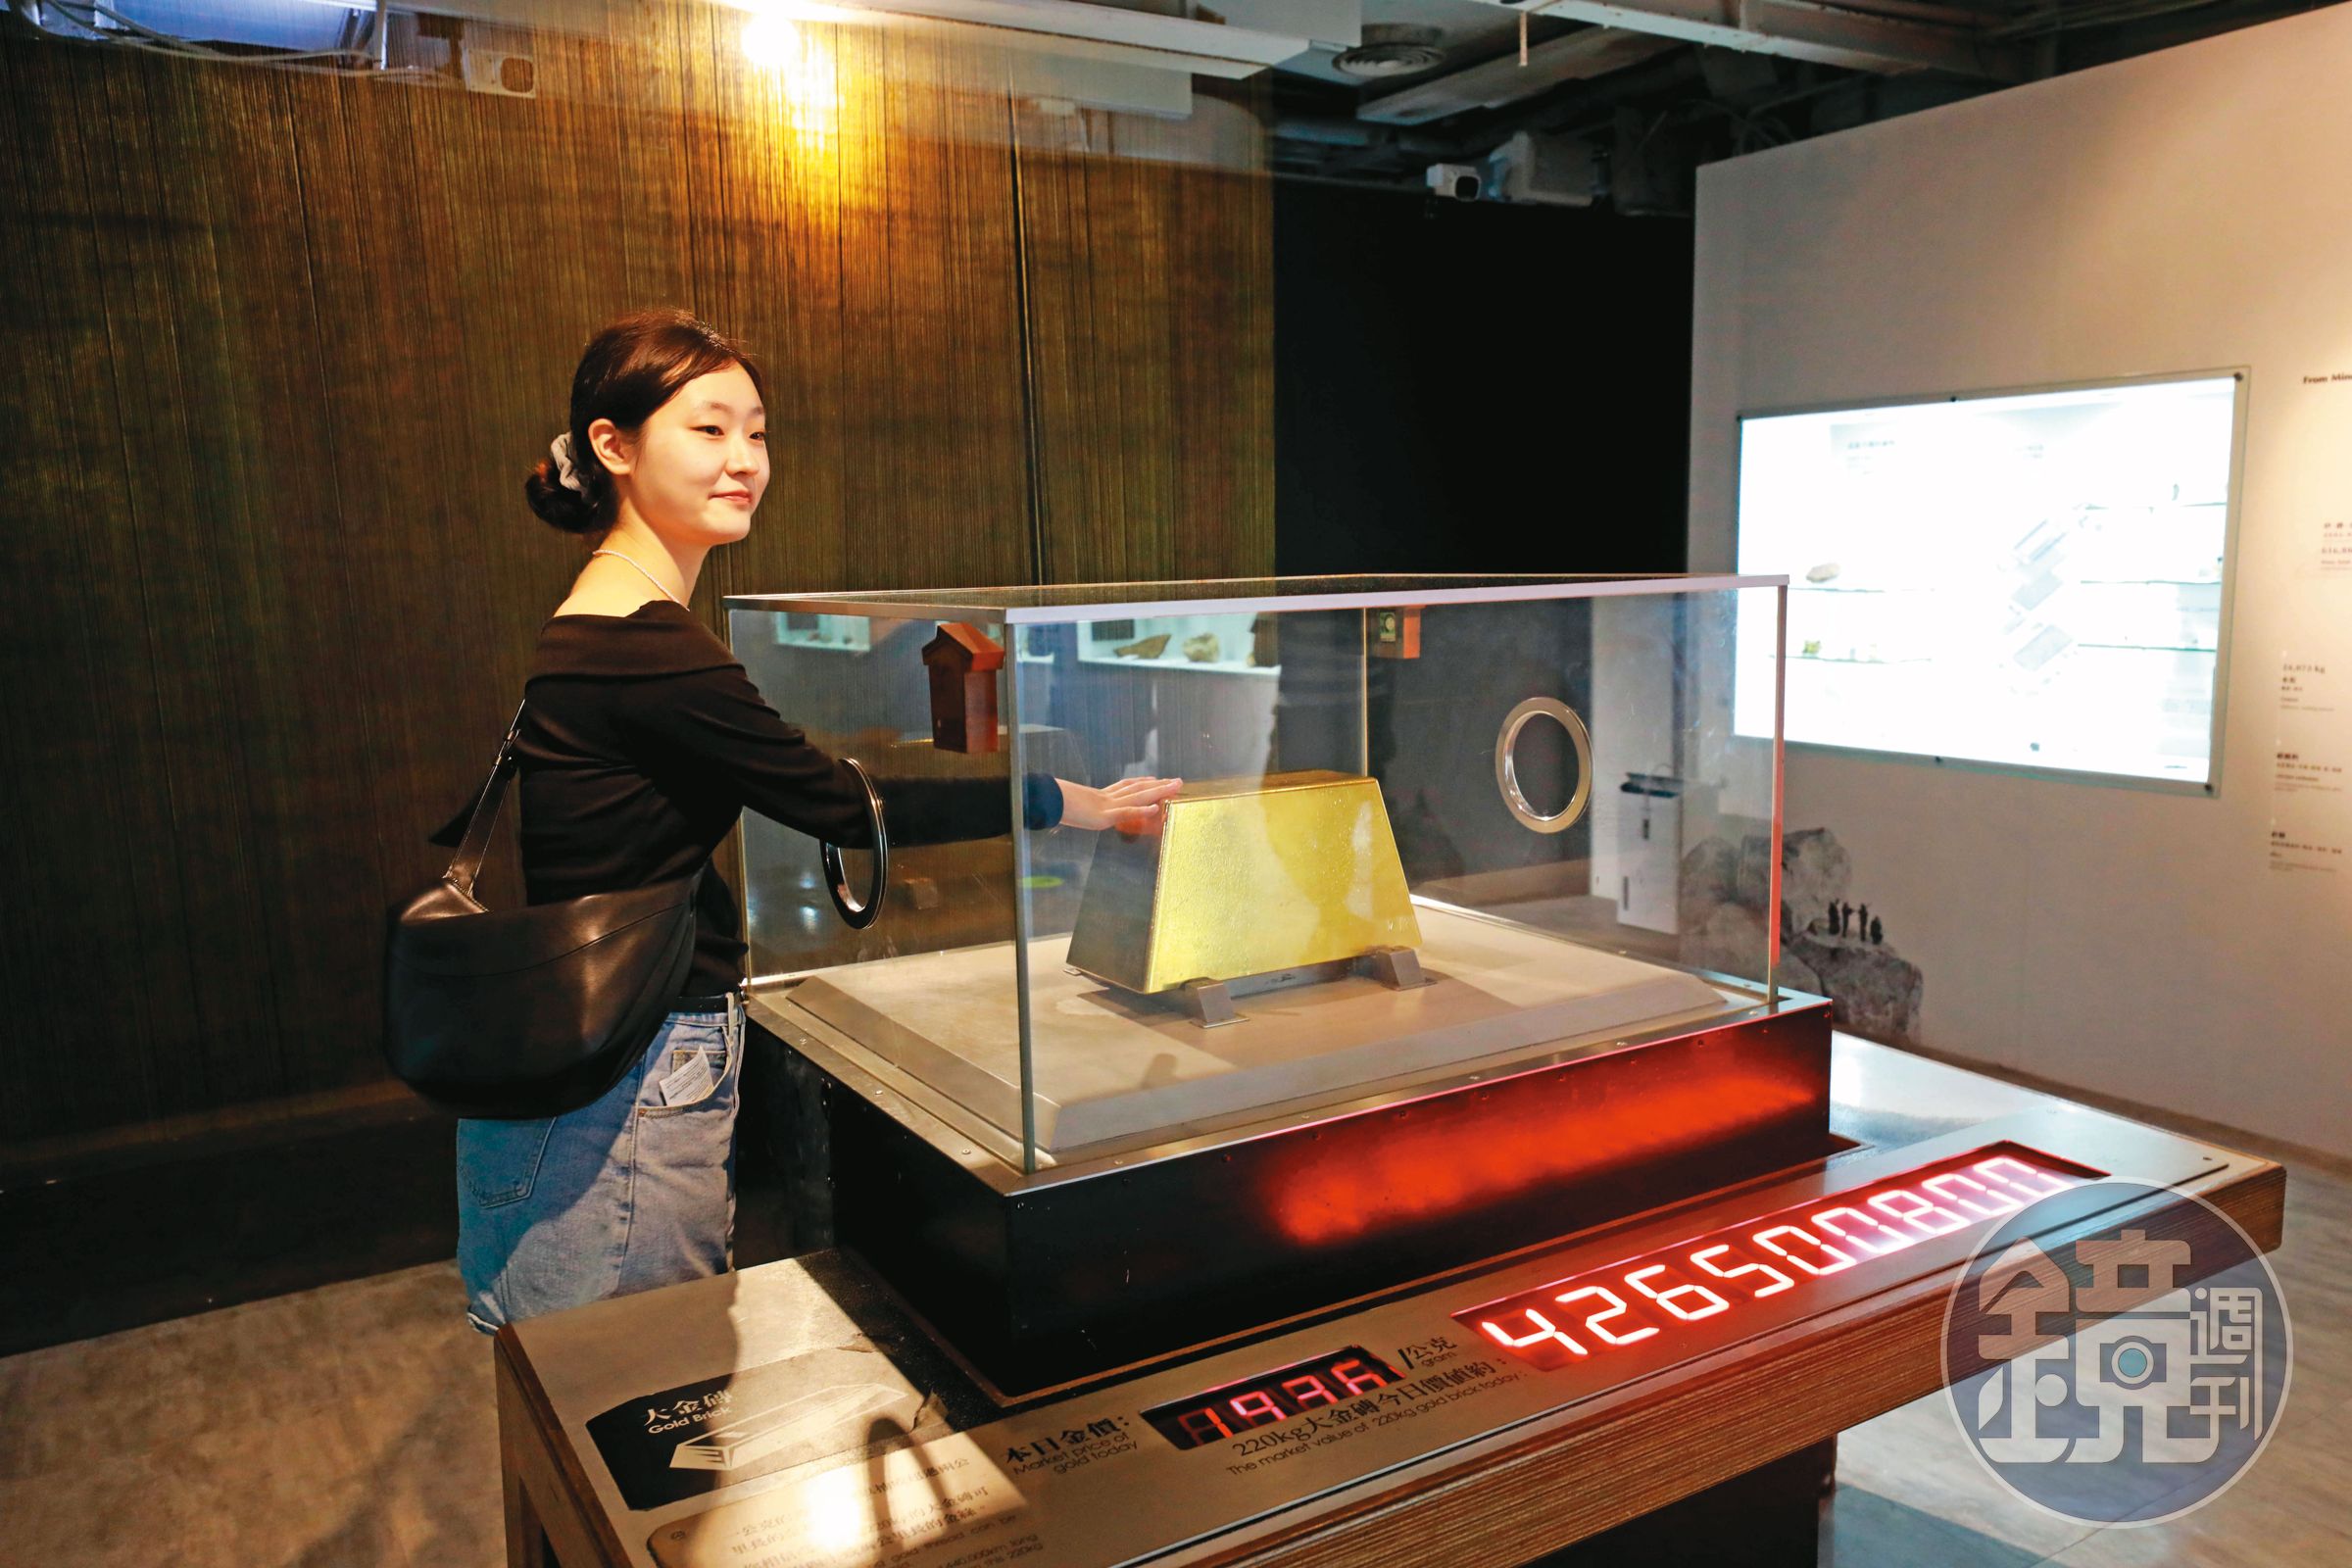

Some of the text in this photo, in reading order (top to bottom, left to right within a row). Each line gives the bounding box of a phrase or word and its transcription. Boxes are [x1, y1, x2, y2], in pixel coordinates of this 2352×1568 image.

[1421, 1351, 1457, 1367] gram
[648, 1406, 733, 1434] Gold Brick
[1227, 1460, 1257, 1475] The
[1258, 1443, 1311, 1465] market
[1312, 1429, 1353, 1446] value
[1354, 1421, 1370, 1433] of
[1372, 1406, 1418, 1427] 220kg
[1416, 1396, 1447, 1413] gold
[1446, 1384, 1483, 1401] brick
[1012, 1431, 1130, 1475] Market price of
[1054, 1440, 1137, 1475] gold today
